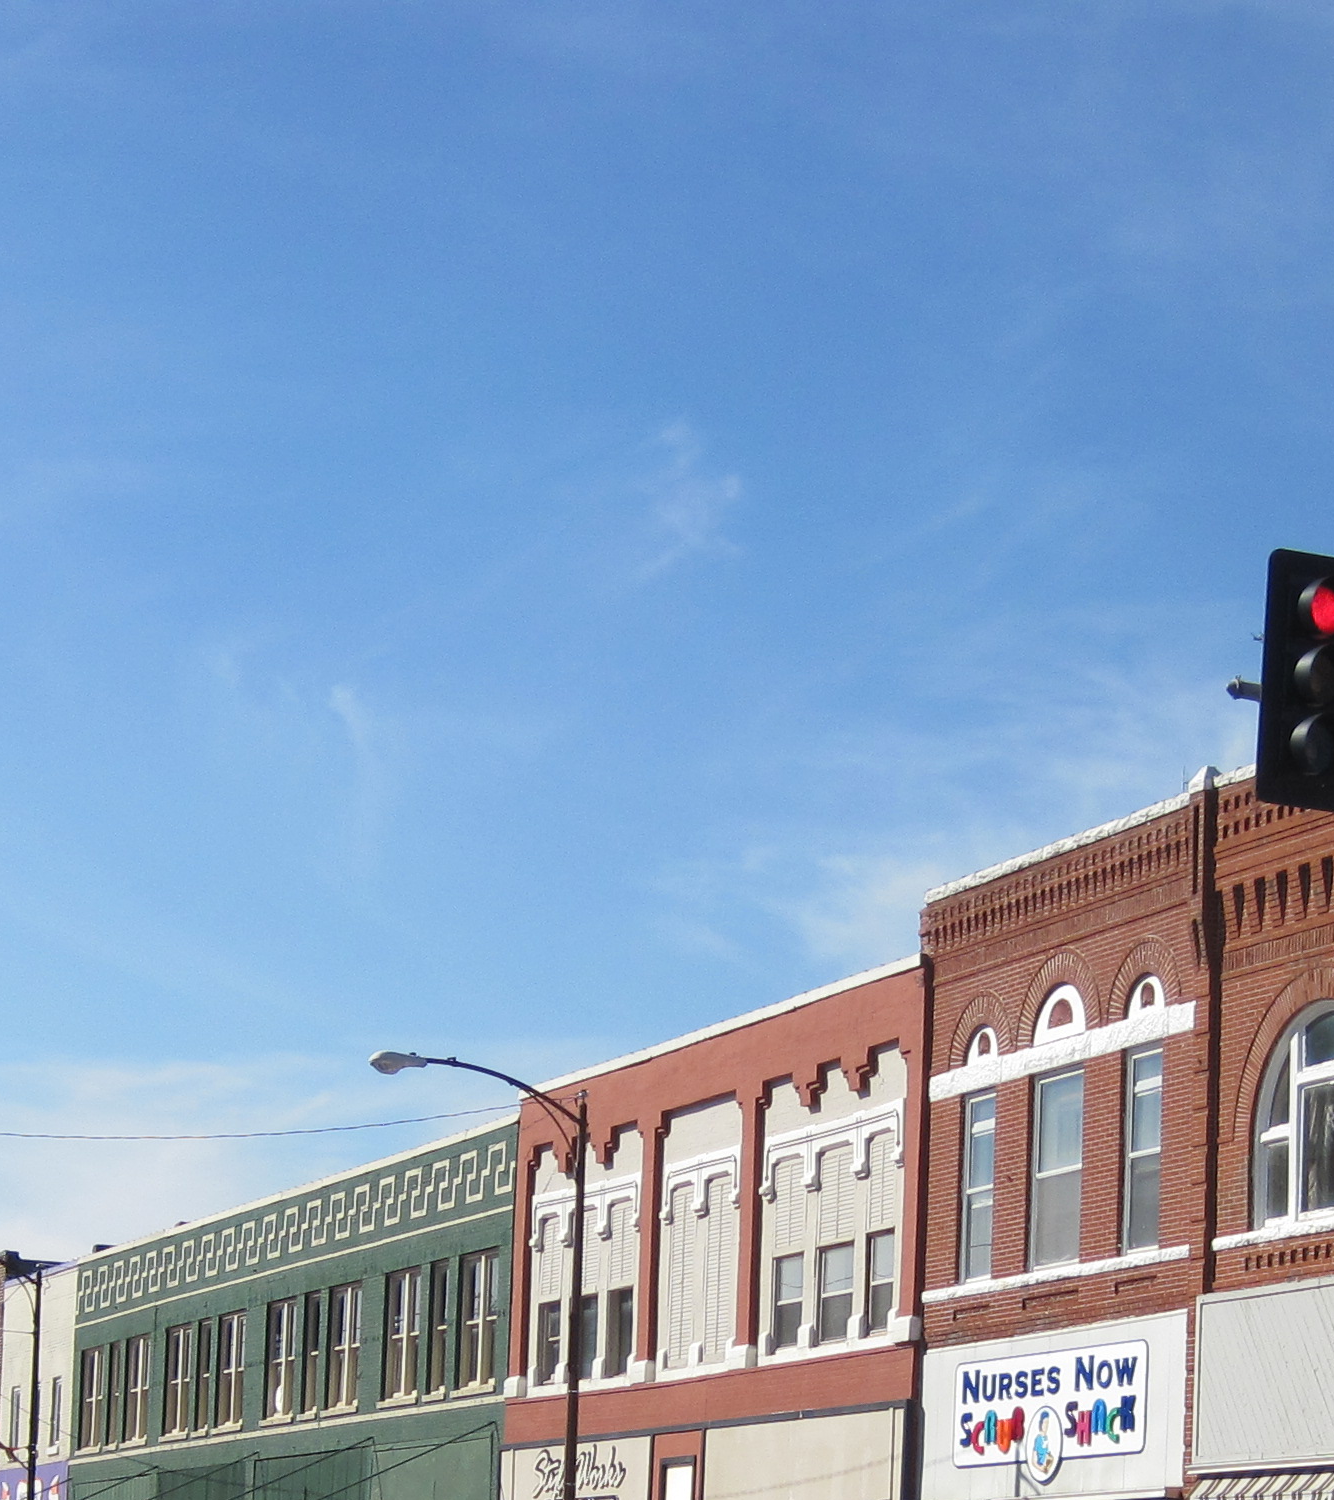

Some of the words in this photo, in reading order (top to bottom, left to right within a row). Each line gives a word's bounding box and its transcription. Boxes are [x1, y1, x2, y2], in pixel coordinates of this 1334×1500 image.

[961, 1366, 1061, 1404] NURSES
[1074, 1355, 1138, 1391] NOW
[960, 1406, 1025, 1455] SCRUB
[1064, 1395, 1136, 1447] SHACK
